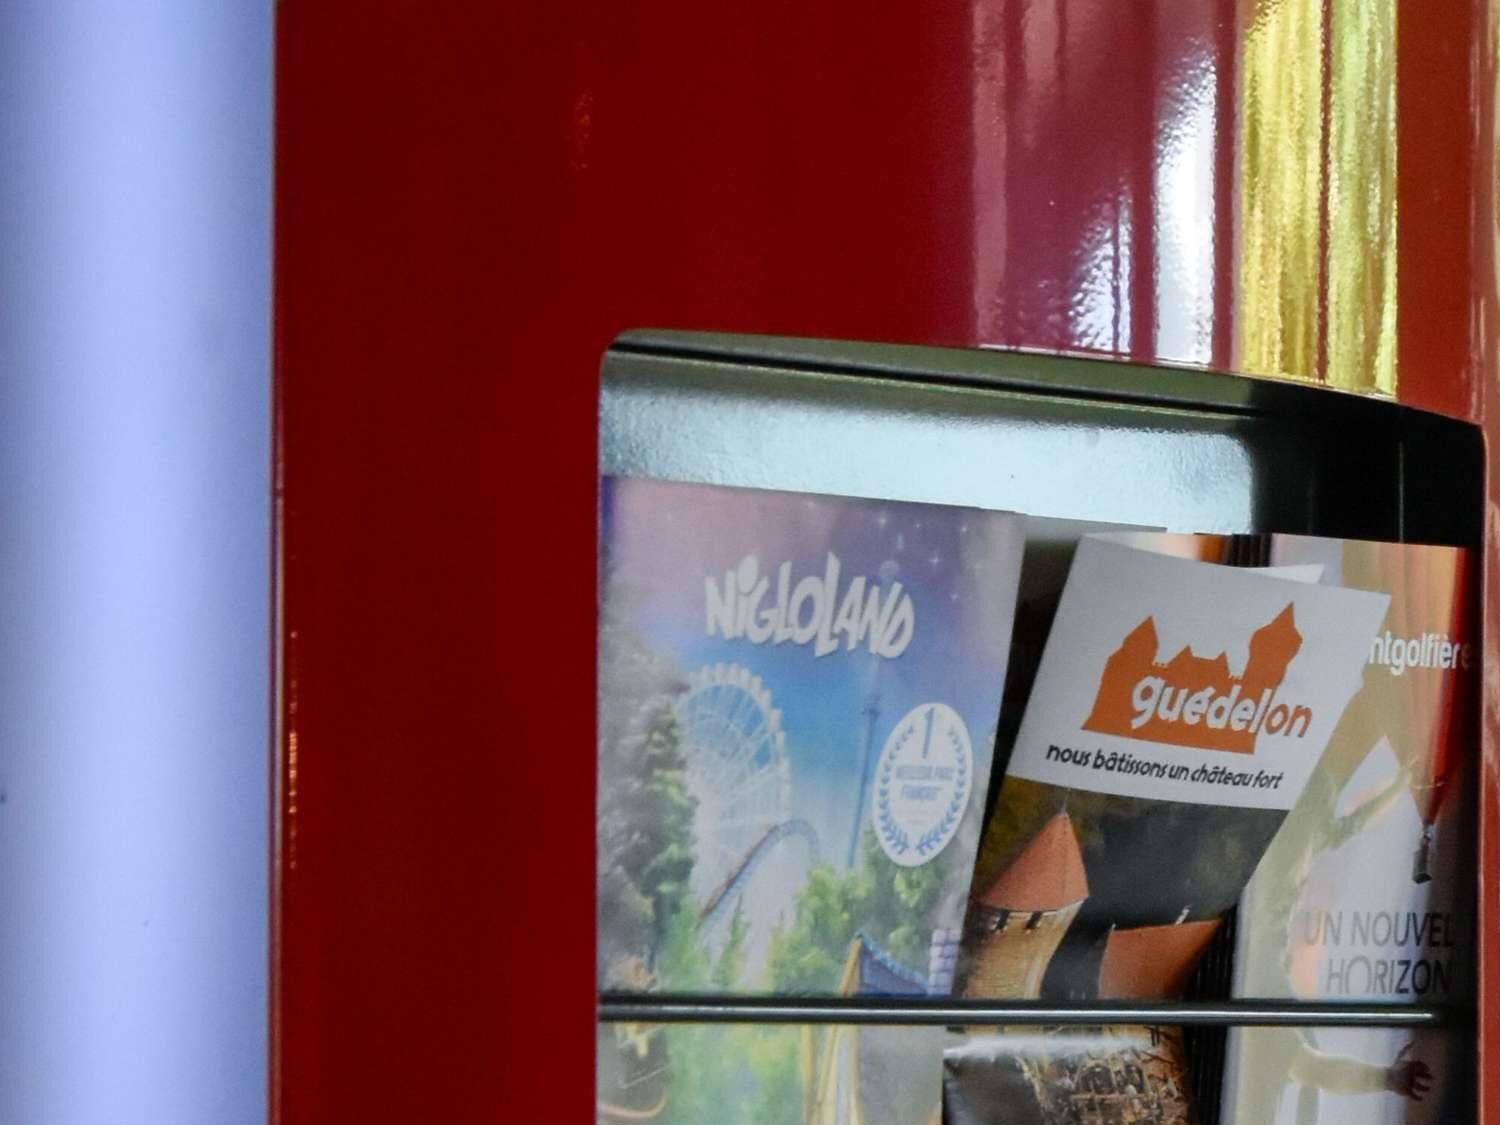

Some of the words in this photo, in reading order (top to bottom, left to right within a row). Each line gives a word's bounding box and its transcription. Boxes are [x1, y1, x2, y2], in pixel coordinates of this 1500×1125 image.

[1046, 743, 1091, 767] nous
[1094, 750, 1168, 778] bâtissons
[1168, 764, 1189, 780] un
[1190, 763, 1253, 786] château
[1251, 769, 1284, 790] fort
[1304, 911, 1343, 947] UN
[1351, 910, 1455, 948] NOUVEL
[1327, 956, 1456, 995] HORIZON
